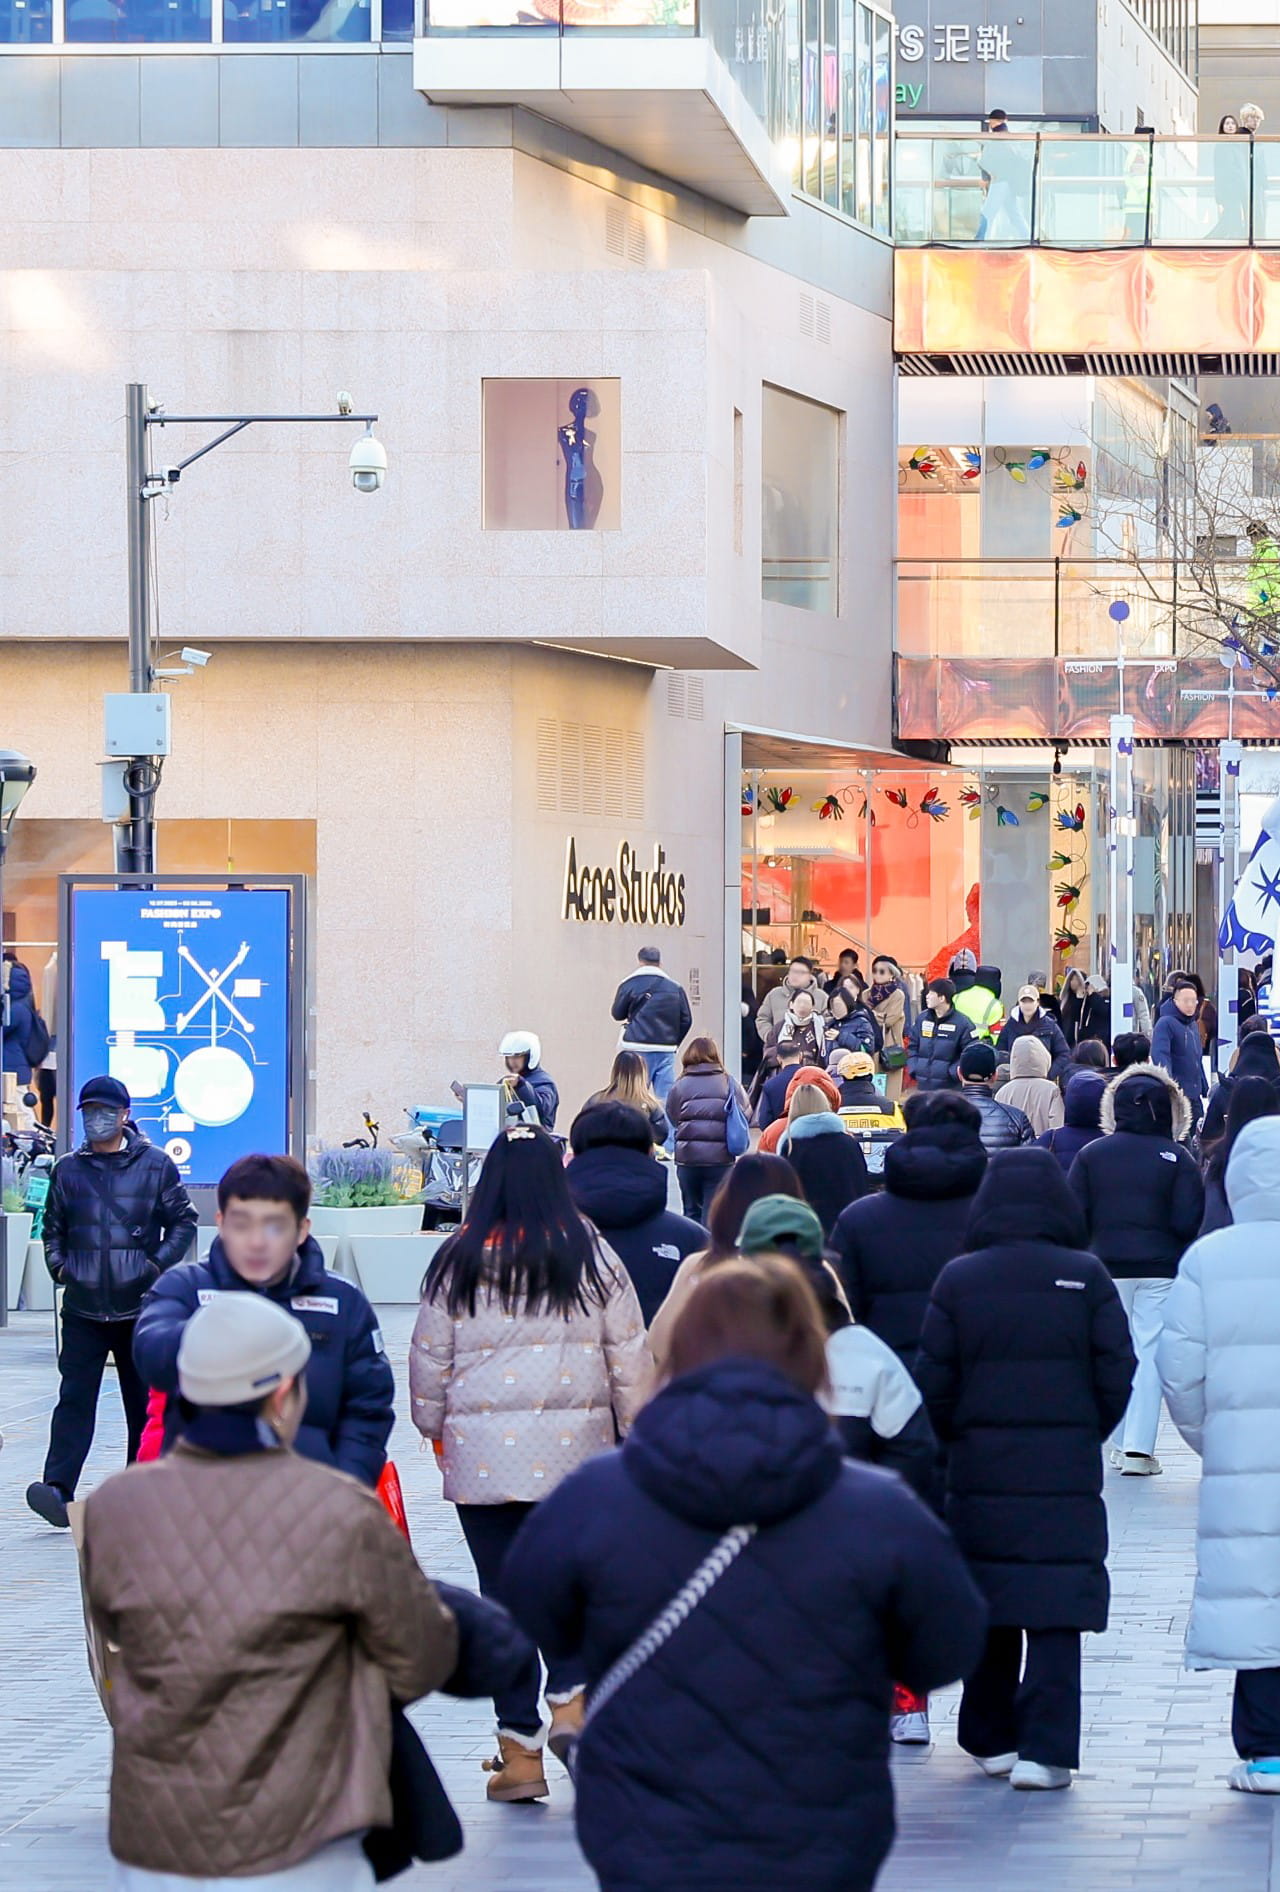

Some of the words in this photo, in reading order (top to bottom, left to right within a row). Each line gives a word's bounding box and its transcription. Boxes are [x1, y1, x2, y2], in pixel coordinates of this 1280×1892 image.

[933, 24, 1013, 62] 泥靴
[1064, 664, 1103, 673] FASHION
[1154, 664, 1178, 673] EXPO
[1180, 693, 1215, 701] FASHION
[562, 836, 616, 923] Acne
[617, 840, 686, 927] Studios
